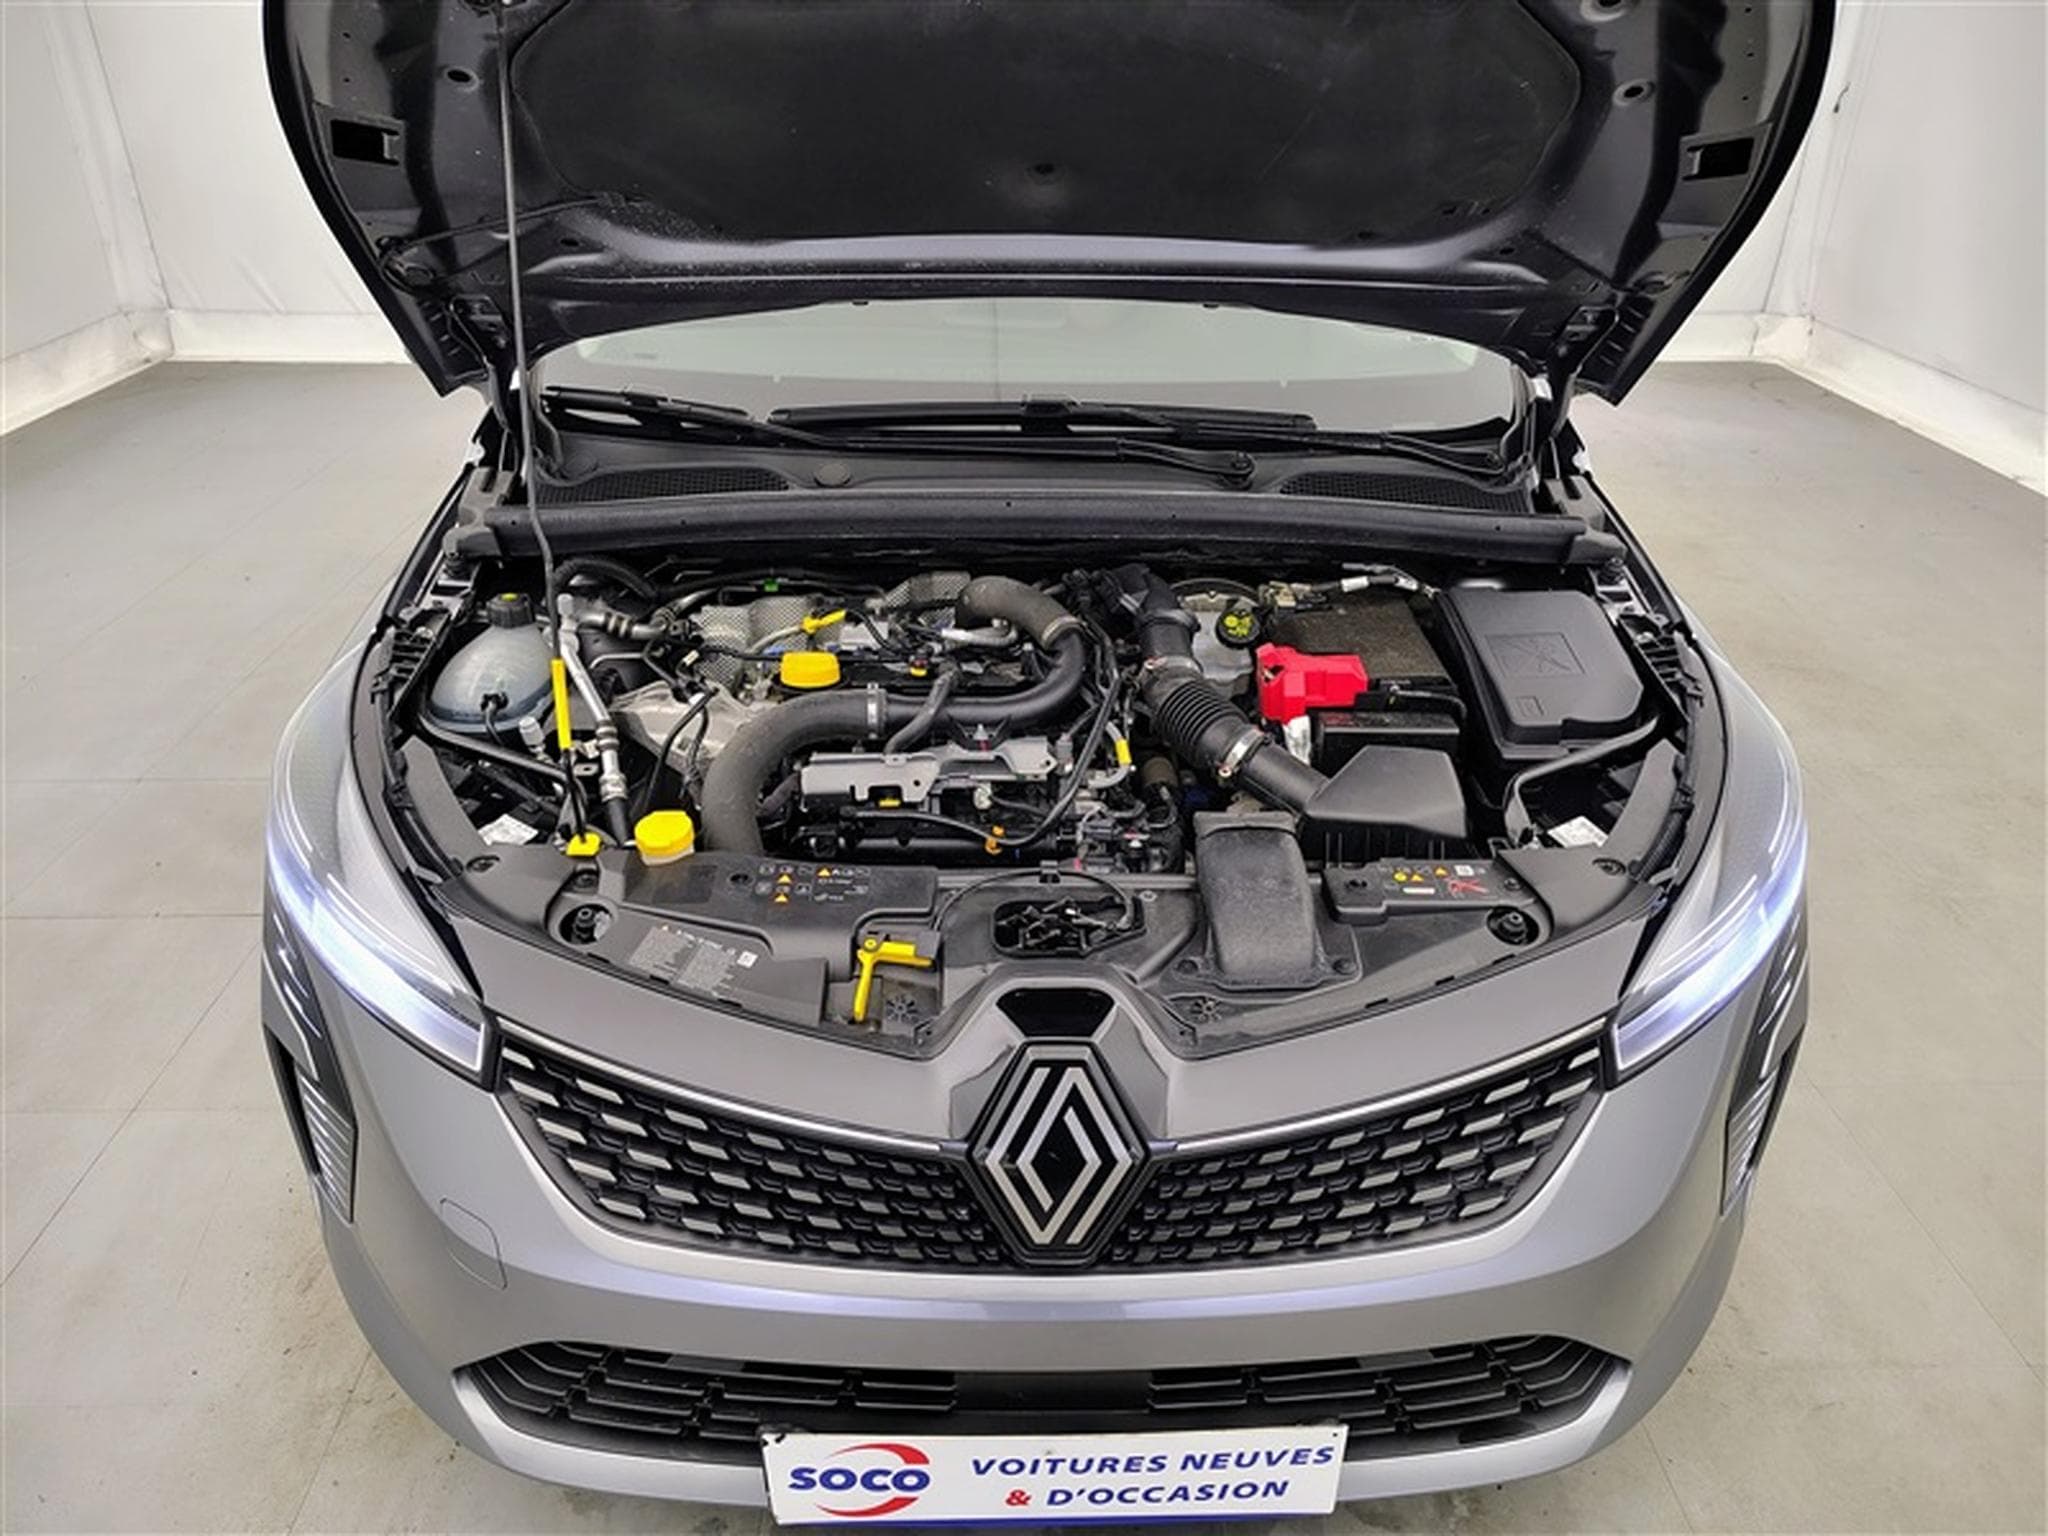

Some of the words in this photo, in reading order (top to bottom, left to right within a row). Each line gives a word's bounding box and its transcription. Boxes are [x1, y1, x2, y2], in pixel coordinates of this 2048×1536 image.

[972, 1454, 1169, 1477] VOITURES
[1179, 1445, 1335, 1472] NEUVES
[788, 1466, 931, 1494] SOCO
[1006, 1489, 1031, 1507] &
[1046, 1480, 1290, 1507] D'OCCASION
